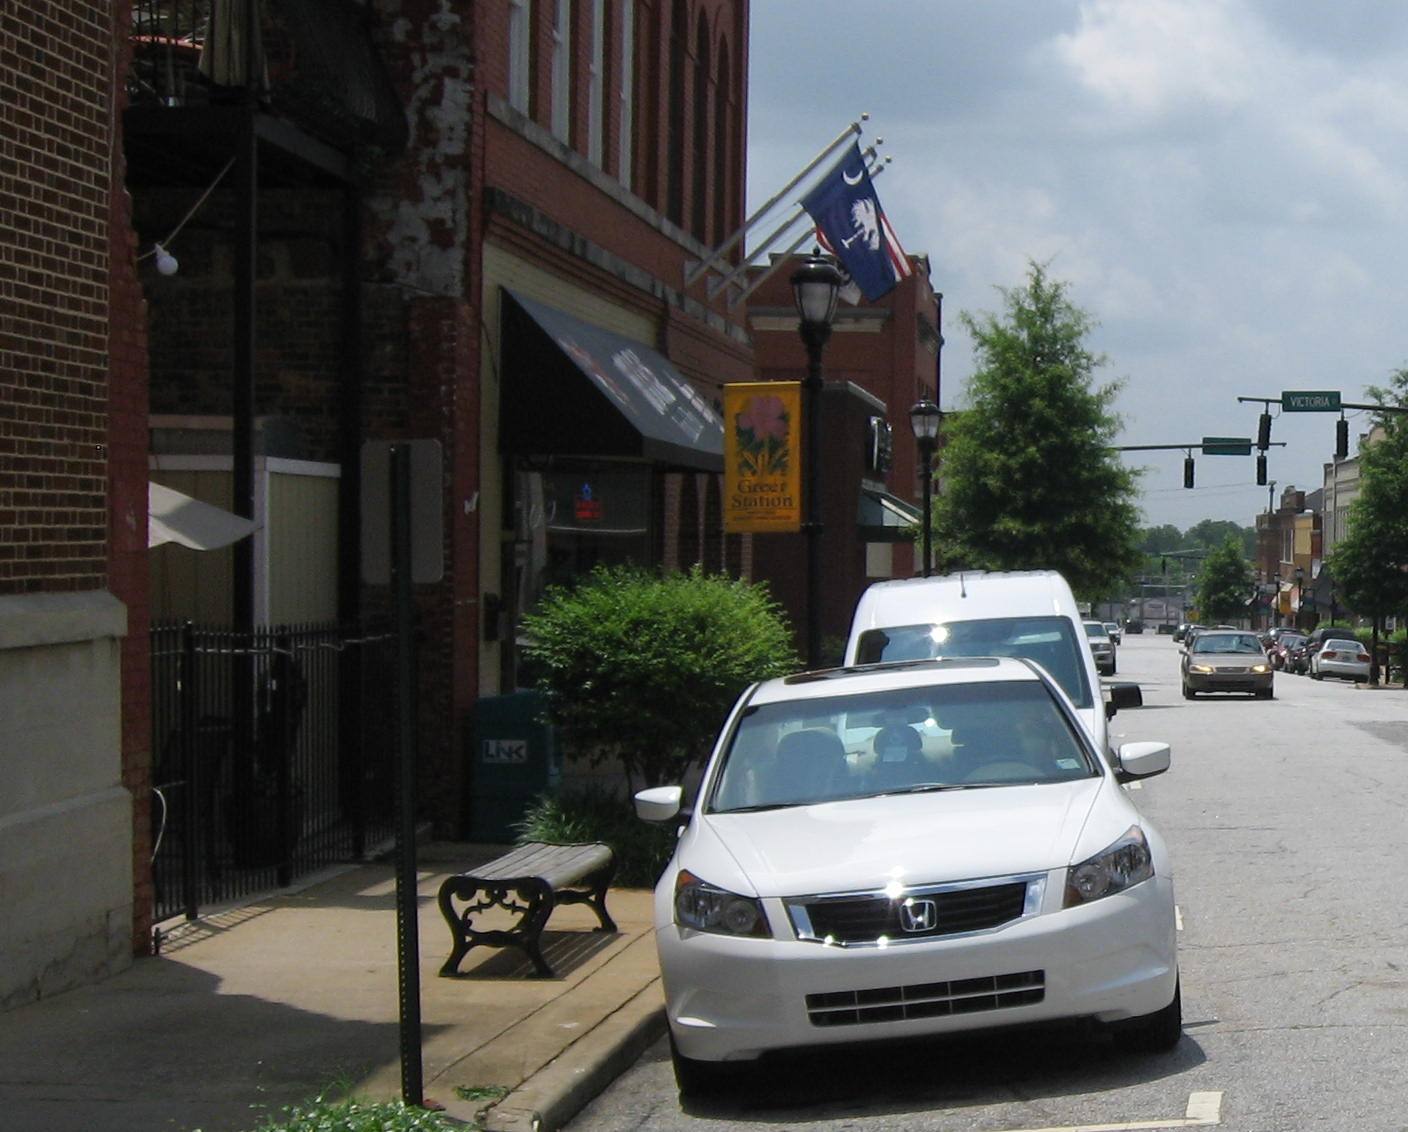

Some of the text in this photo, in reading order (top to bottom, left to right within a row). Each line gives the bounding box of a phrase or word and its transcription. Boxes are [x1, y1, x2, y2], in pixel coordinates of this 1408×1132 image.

[1290, 396, 1330, 408] VICTORIA
[738, 480, 786, 494] Greer
[732, 495, 793, 508] Station
